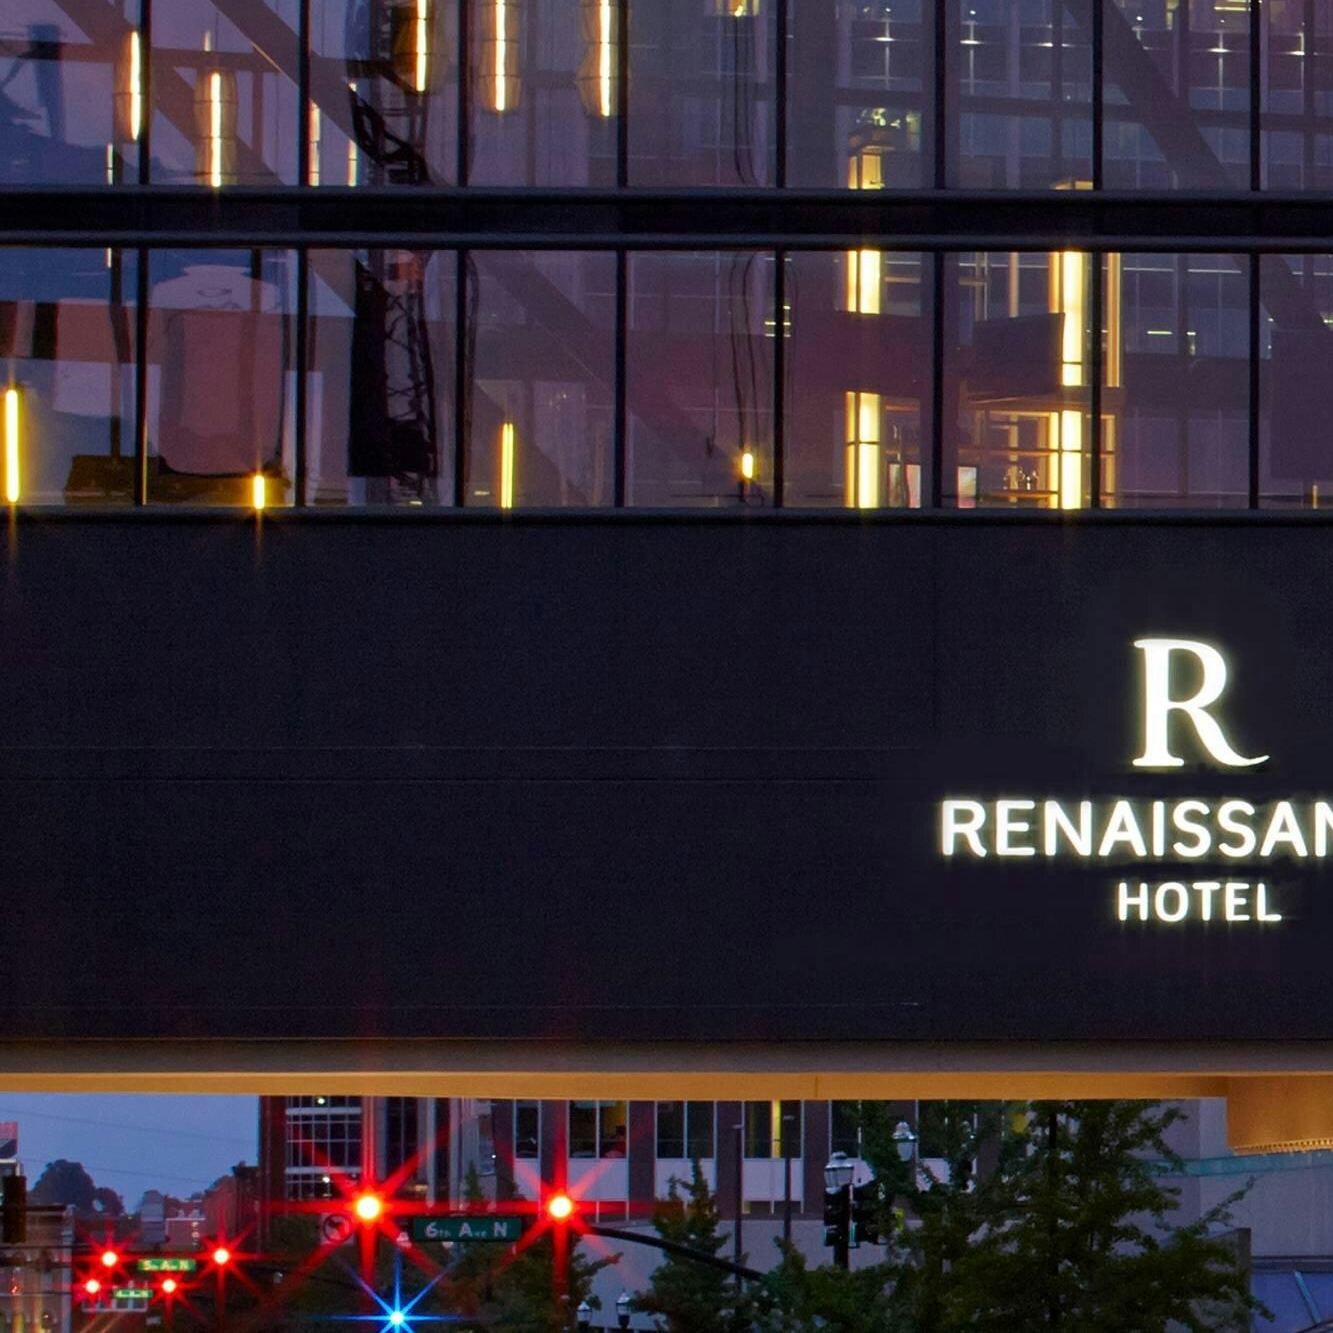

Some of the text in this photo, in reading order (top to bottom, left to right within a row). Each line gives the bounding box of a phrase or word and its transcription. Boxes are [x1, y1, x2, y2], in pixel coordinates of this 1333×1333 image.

[1132, 638, 1270, 767] R
[1118, 882, 1282, 921] HOTEL
[493, 1221, 507, 1237] N
